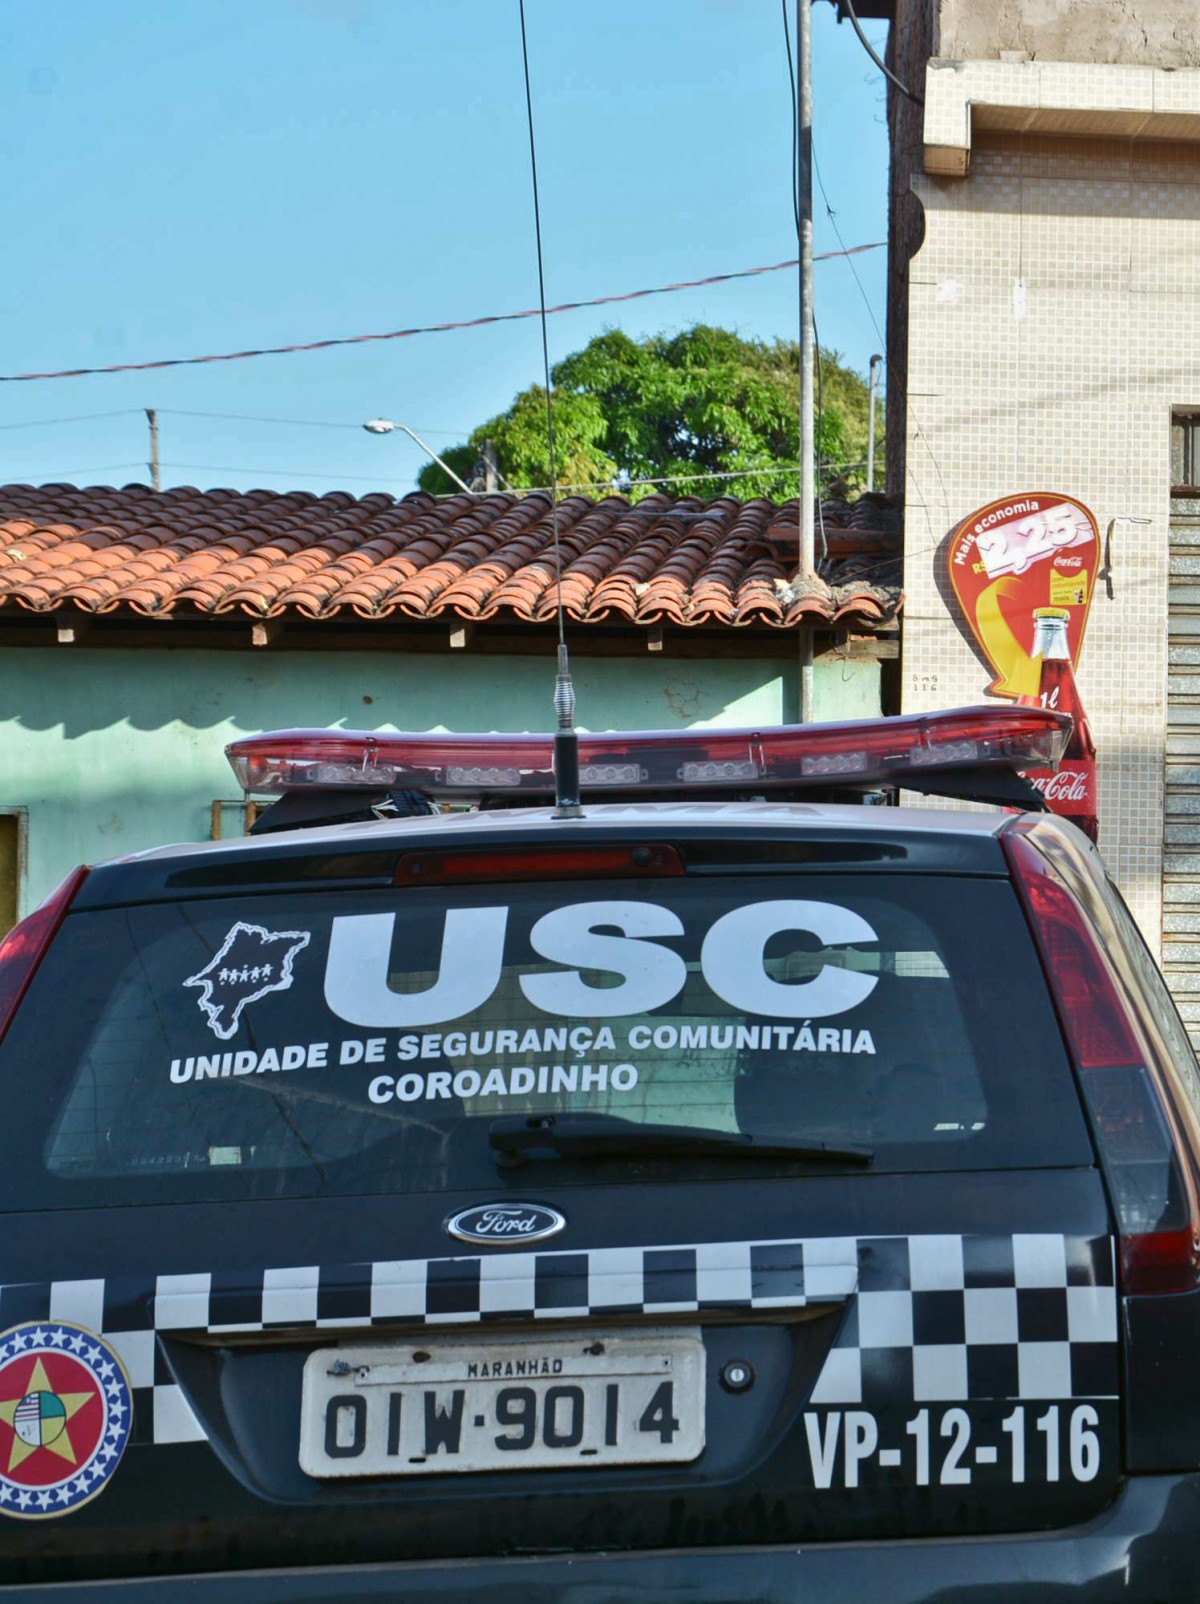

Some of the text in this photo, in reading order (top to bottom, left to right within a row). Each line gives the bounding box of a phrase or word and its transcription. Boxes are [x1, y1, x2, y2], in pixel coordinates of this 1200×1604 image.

[954, 499, 1040, 566] Mais economia
[323, 899, 880, 1028] USC
[169, 1019, 877, 1084] UNIDADE DE SEGURANÇA COMUNITÁRIA
[367, 1063, 639, 1104] COROADINHO
[475, 1209, 537, 1233] Ford
[467, 1357, 563, 1379] MARANHÃO
[803, 1404, 1100, 1489] VP-12-116
